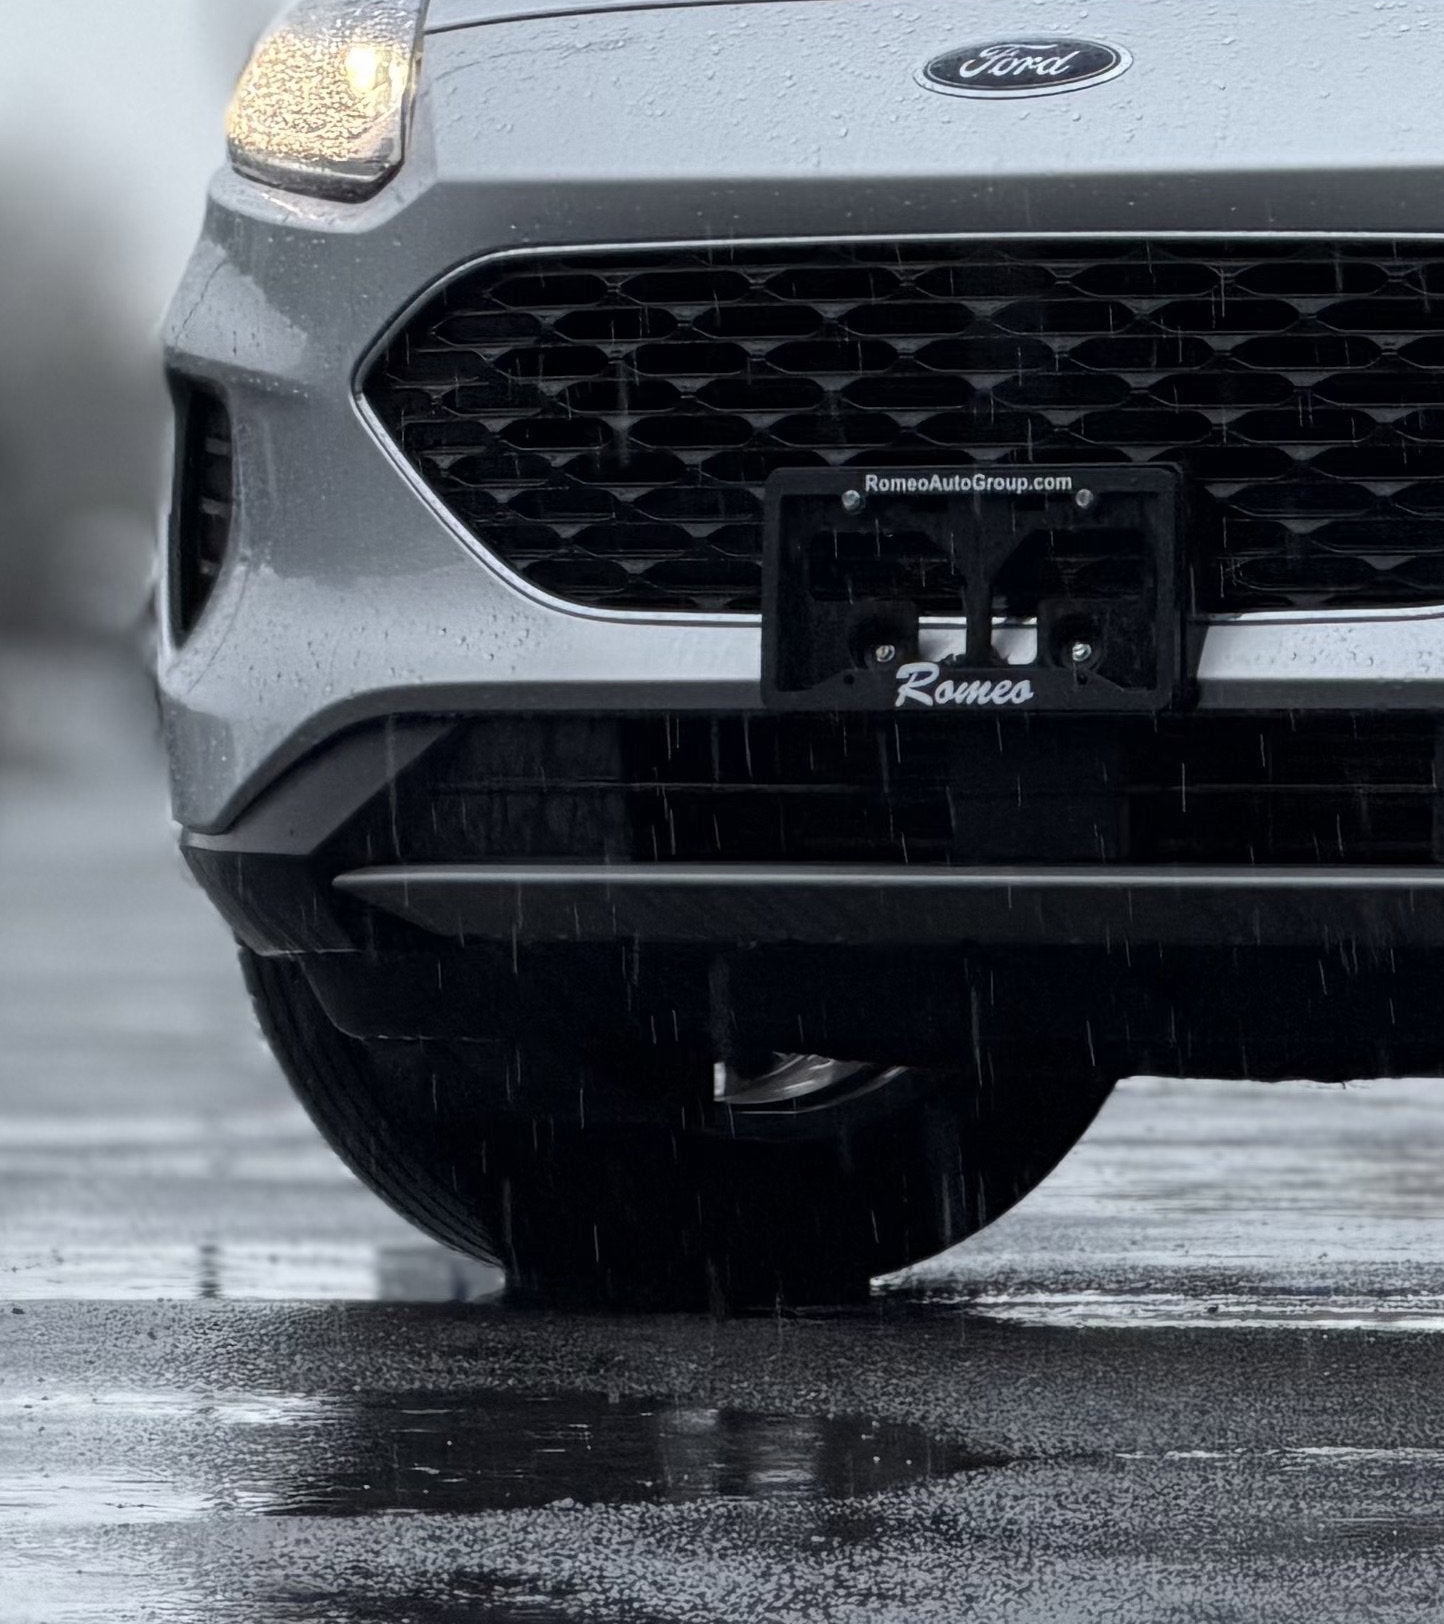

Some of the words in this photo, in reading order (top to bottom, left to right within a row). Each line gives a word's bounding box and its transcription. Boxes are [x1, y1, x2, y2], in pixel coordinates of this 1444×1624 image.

[959, 43, 1081, 78] Ford
[866, 474, 1072, 494] RomeoAutoGroup.com
[895, 663, 1034, 708] Romeo
